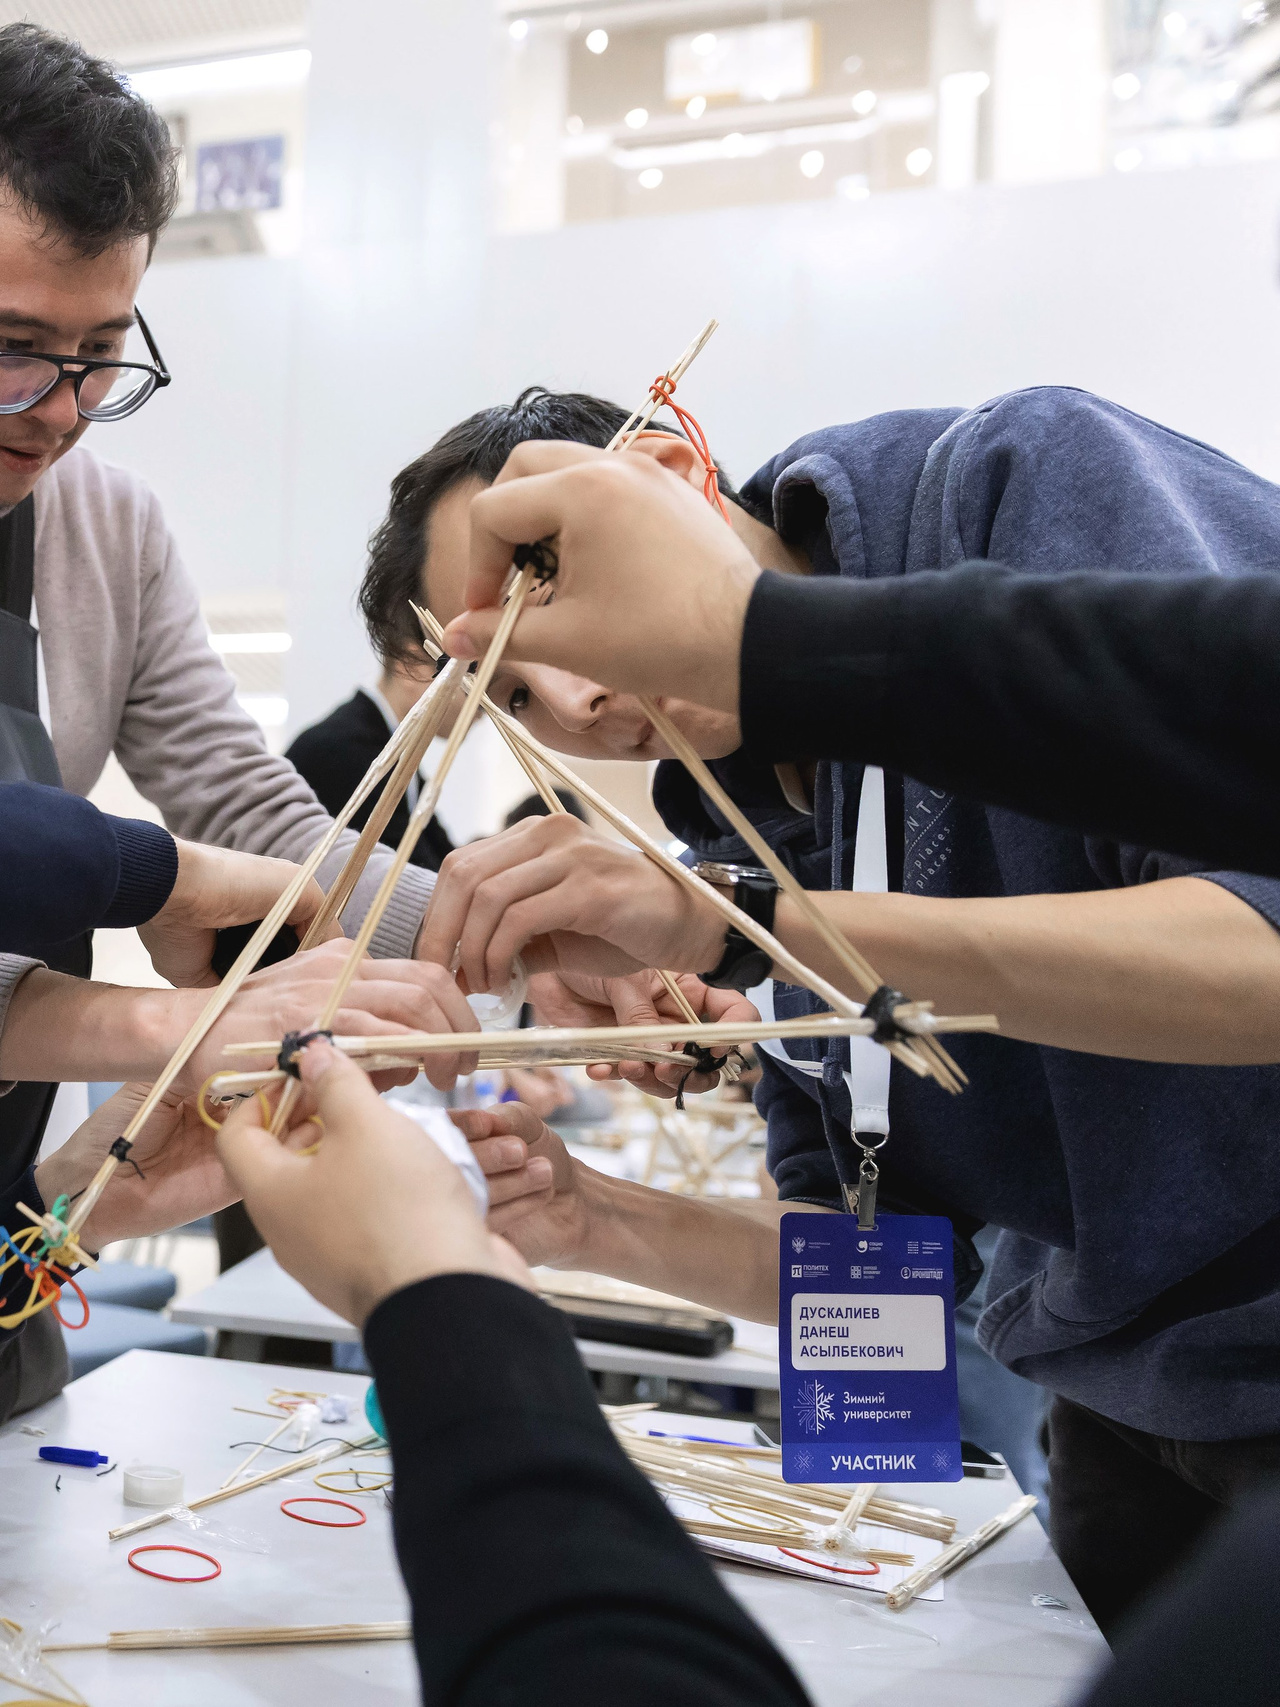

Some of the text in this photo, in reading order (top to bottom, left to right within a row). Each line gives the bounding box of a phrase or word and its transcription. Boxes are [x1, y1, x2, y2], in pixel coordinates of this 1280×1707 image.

[912, 1270, 943, 1280] КРОНШТАДТ
[799, 1306, 880, 1320] ДУСКАЛИЕВ
[799, 1326, 849, 1340] ДАНЕШ
[800, 1345, 904, 1358] АСЫЛБЕКОВИЧ
[843, 1391, 885, 1404] Зимний
[843, 1410, 912, 1423] университет
[831, 1454, 917, 1471] УЧАСТНИК
